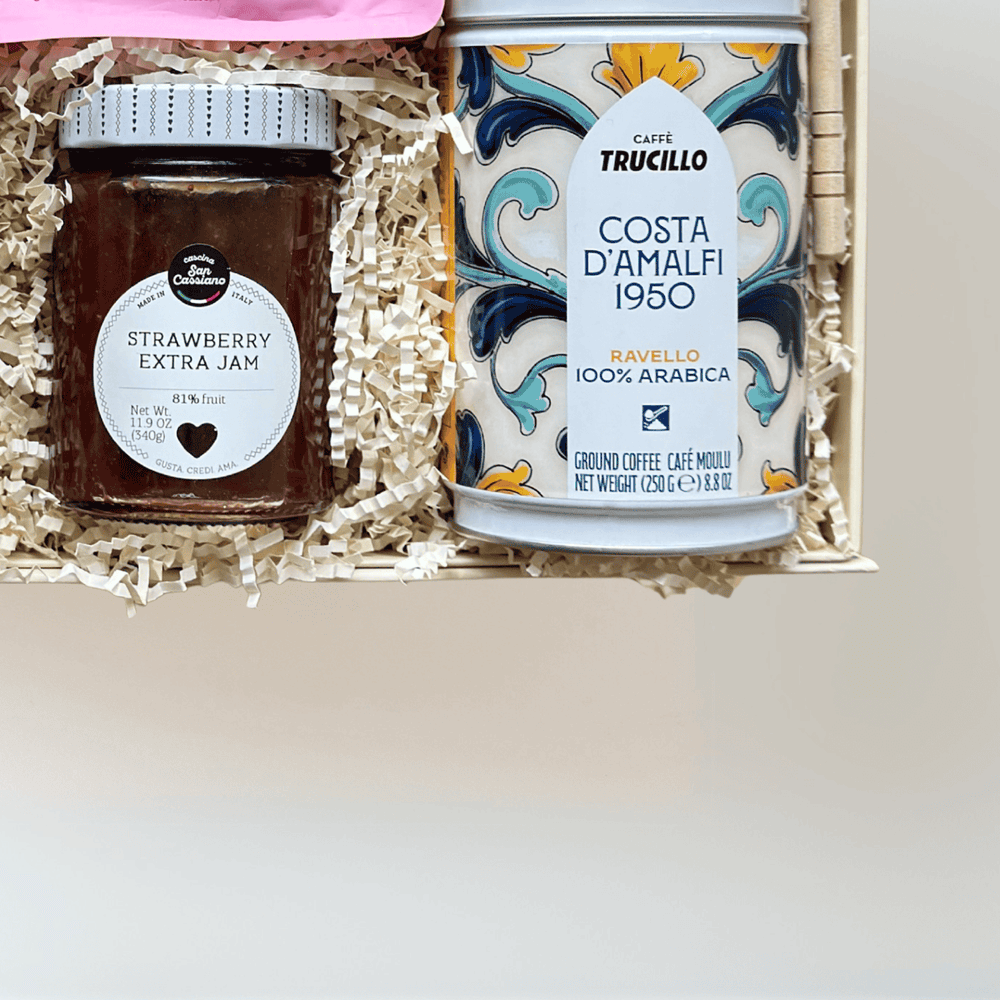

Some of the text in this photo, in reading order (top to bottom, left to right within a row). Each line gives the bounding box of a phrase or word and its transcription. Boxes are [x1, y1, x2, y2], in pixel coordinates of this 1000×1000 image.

[633, 131, 673, 143] CAFFÈ
[600, 149, 708, 171] TRUCILLO
[599, 216, 709, 244] COSTA
[183, 253, 215, 265] cascina
[187, 264, 212, 276] San
[173, 274, 226, 286] Cassiano
[137, 294, 156, 310] MADE
[231, 291, 253, 306] ITALY
[615, 283, 695, 310] 1950
[127, 331, 271, 349] STRAWBERRY
[139, 354, 259, 371] EXTRA JAM
[610, 349, 700, 363] RAVELLO
[576, 368, 731, 383] 100% ARABICA
[172, 394, 226, 404] 81% fruit
[130, 405, 172, 416] Net Wt.
[130, 418, 172, 428] 11.9 OZ
[131, 430, 166, 443] (340g)
[155, 458, 239, 475] GUSTA. CREDI. AMA.
[575, 448, 731, 471] GROUND COFFEE CAFÉ MOULU
[575, 474, 596, 493] NET
[597, 474, 638, 493] WEIGHT
[704, 474, 720, 492] 8.8
[721, 473, 732, 491] OZ
